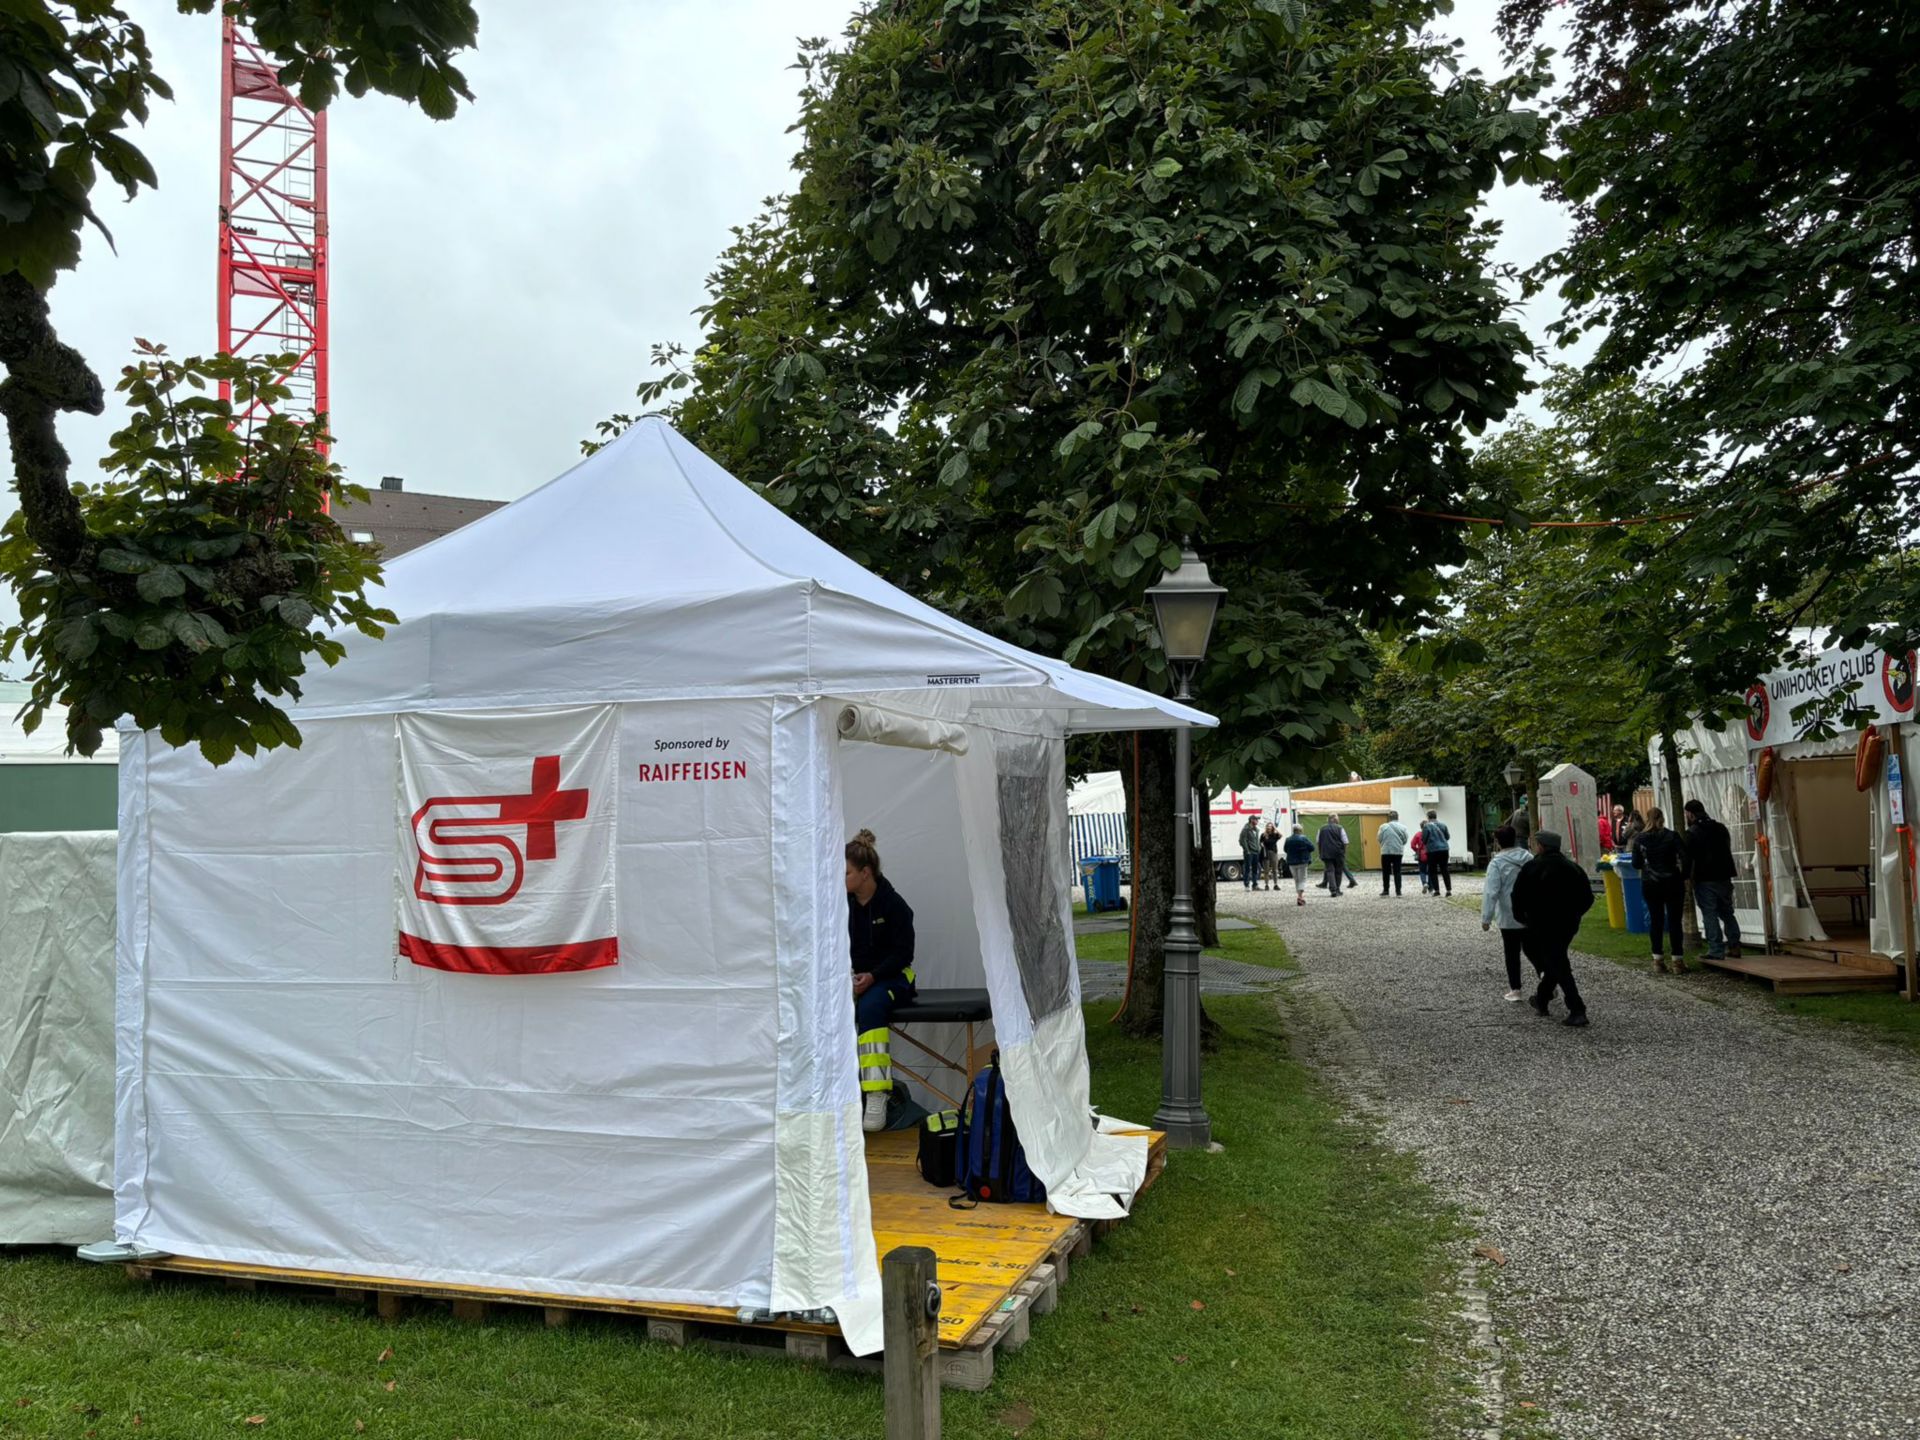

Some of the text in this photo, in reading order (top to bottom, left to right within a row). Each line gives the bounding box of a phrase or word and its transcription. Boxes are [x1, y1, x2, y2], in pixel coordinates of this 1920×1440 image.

[927, 676, 980, 685] MASTERTENT
[1770, 653, 1876, 700] UNIHOCKEY CLUB
[653, 737, 730, 752] Sponsored by
[639, 761, 746, 781] RAIFFEISEN
[936, 1257, 981, 1267] oka
